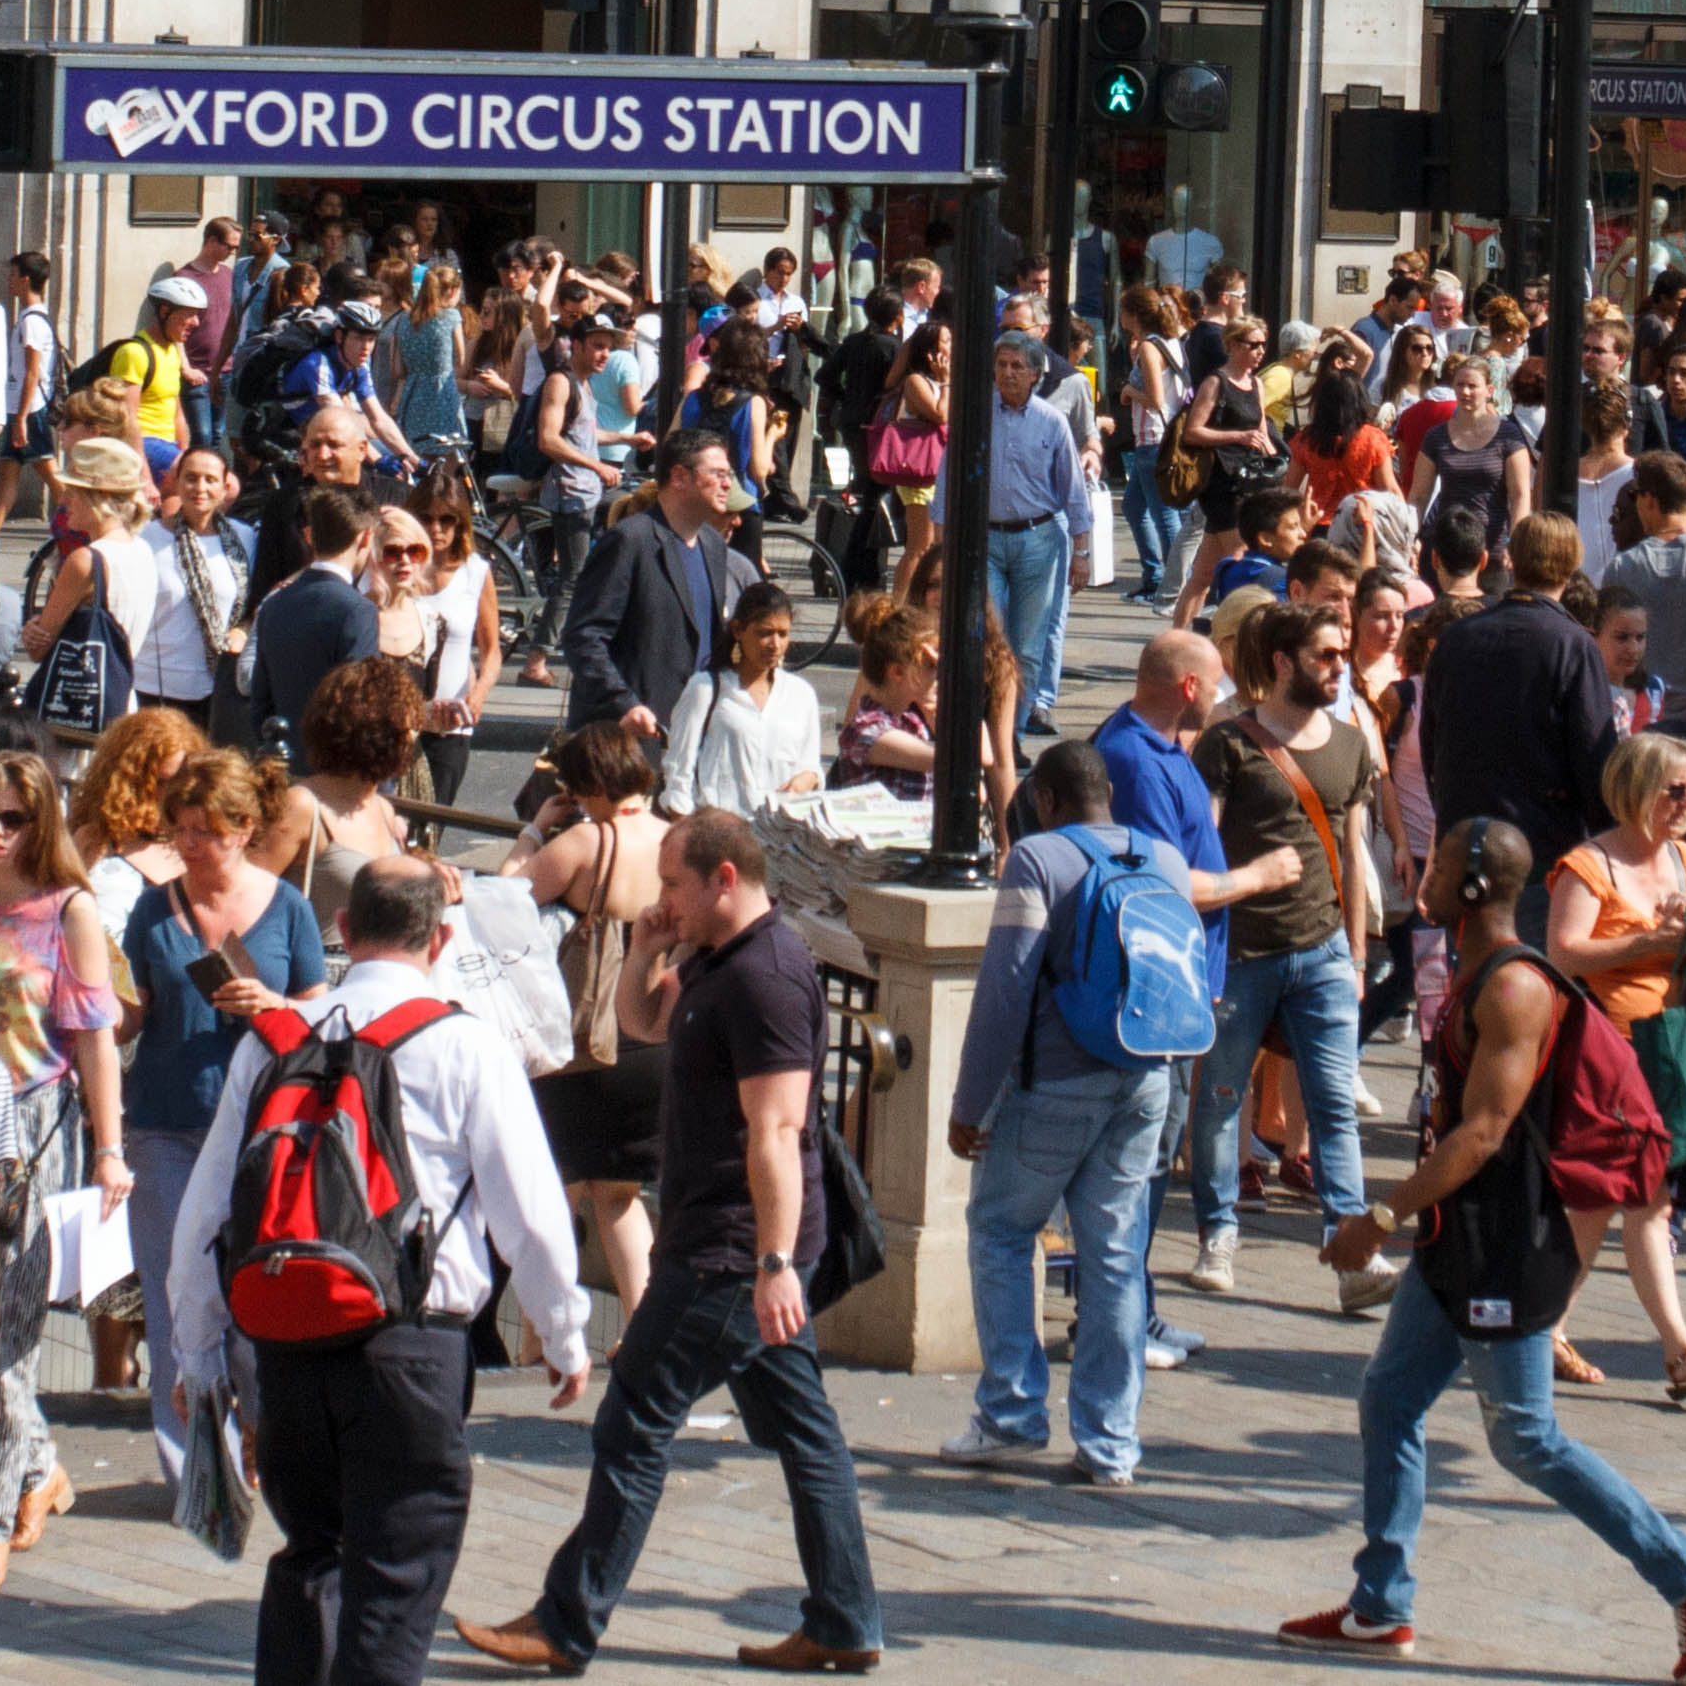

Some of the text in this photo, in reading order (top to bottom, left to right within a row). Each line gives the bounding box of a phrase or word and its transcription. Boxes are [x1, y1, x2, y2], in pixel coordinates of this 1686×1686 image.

[115, 88, 388, 148] XFORD
[412, 93, 643, 152] CIRCUS
[664, 97, 921, 155] STATION
